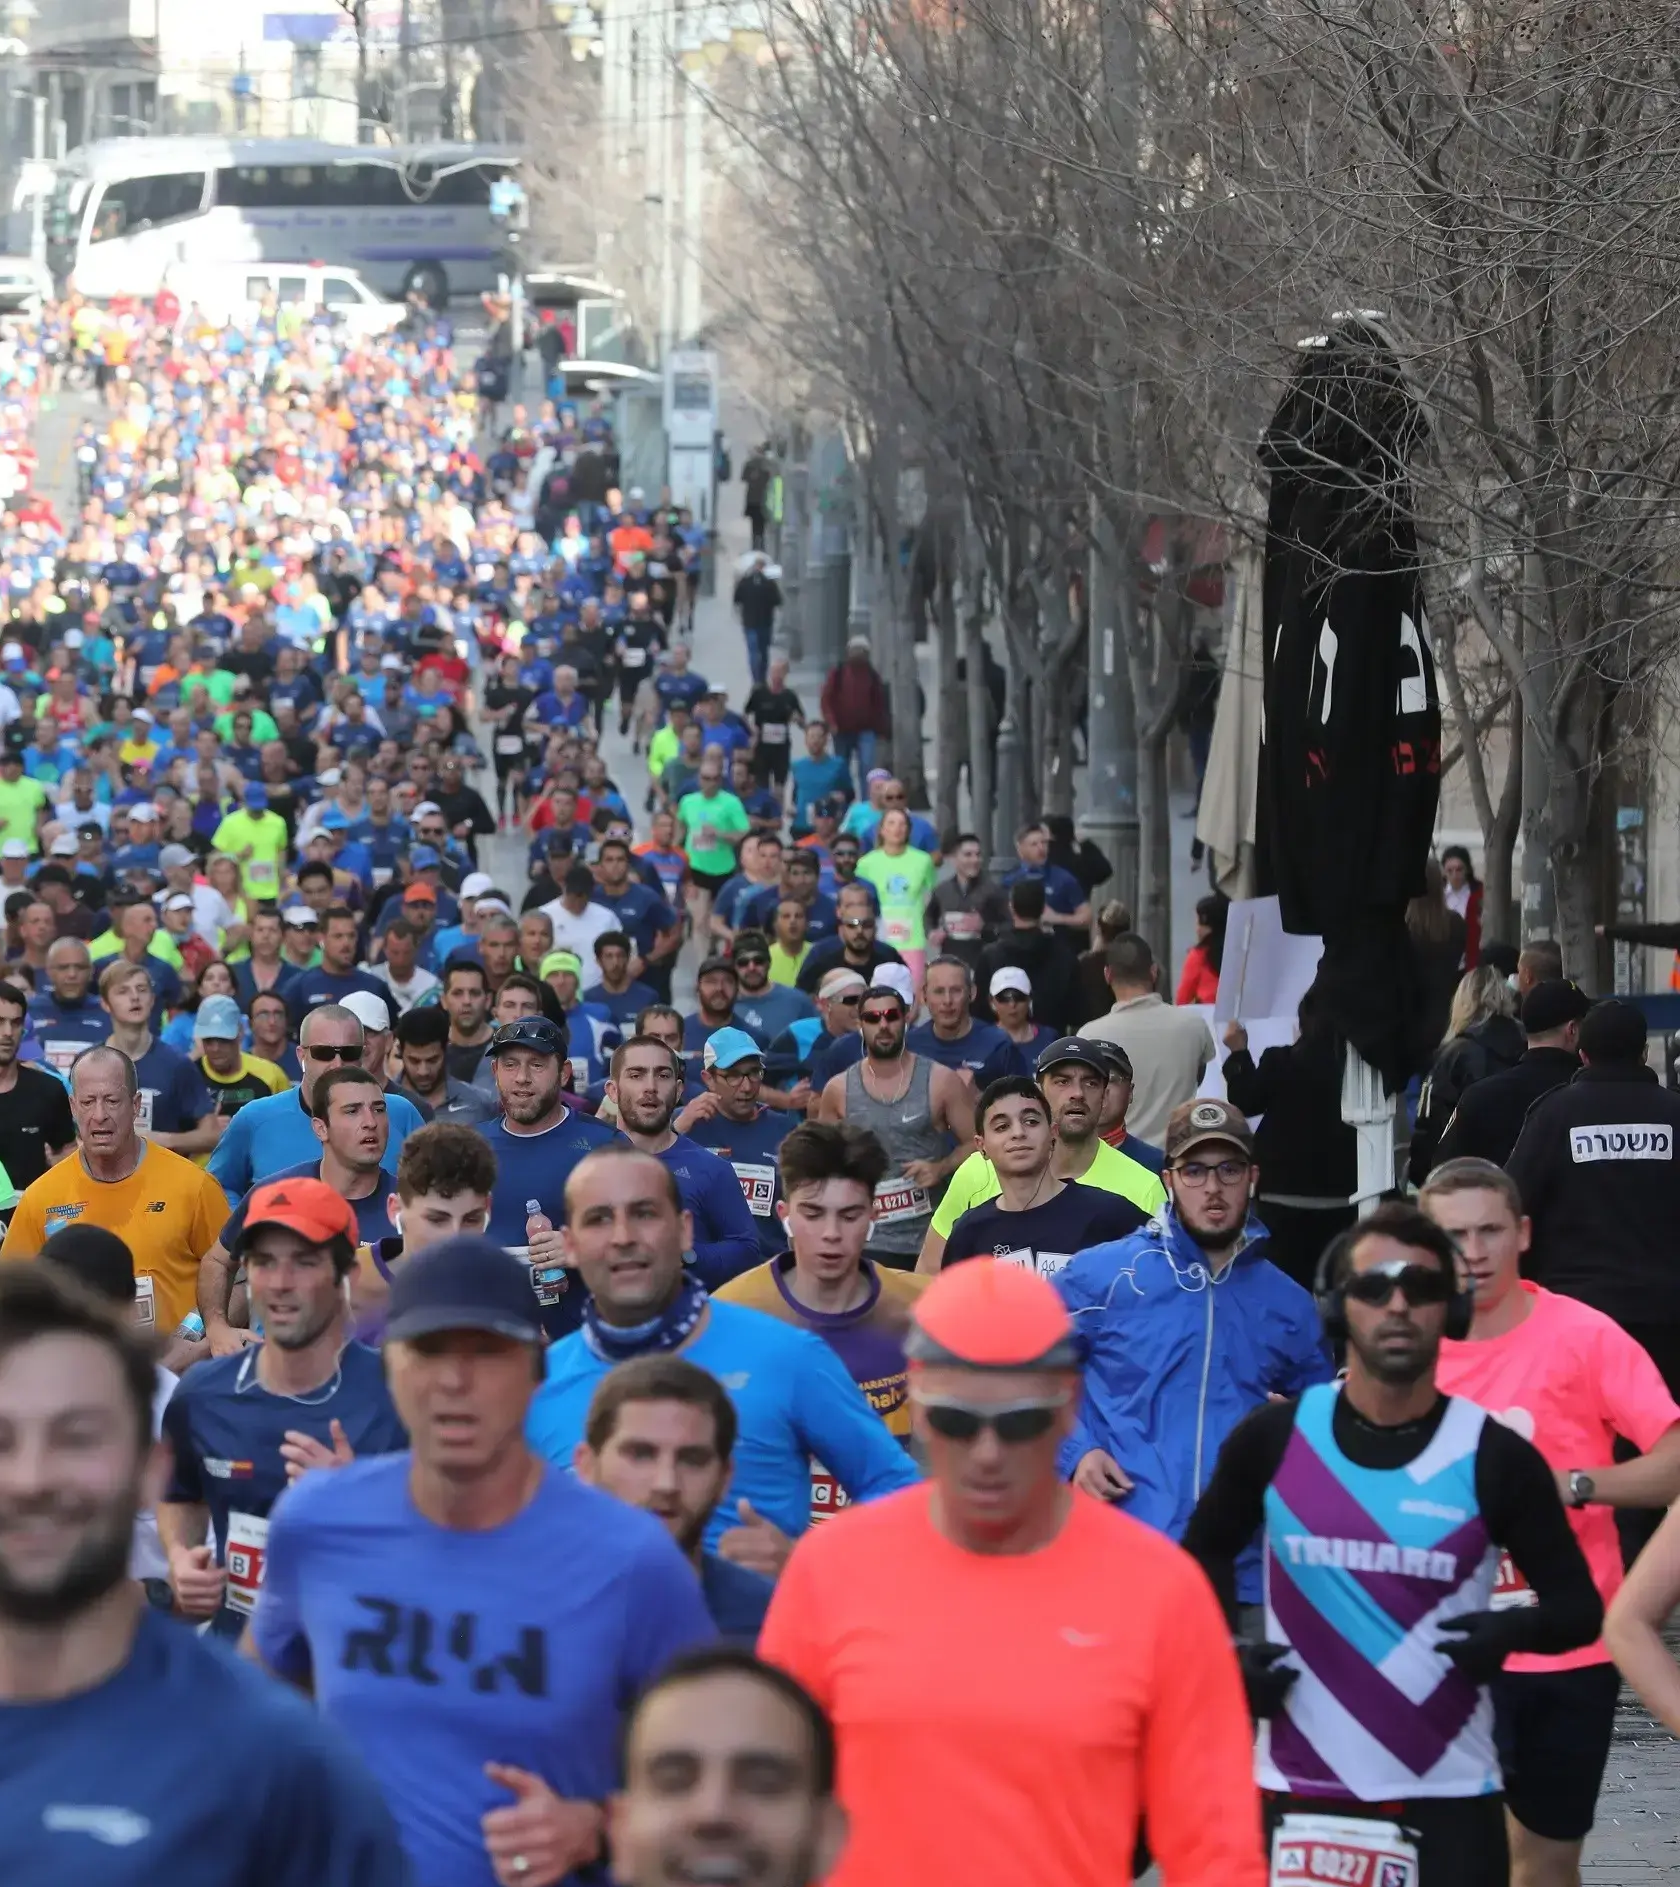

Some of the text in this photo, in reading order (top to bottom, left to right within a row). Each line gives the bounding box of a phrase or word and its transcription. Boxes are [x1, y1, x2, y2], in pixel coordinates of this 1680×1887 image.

[1575, 1133, 1669, 1154] משטרה
[815, 1486, 827, 1501] C
[232, 1555, 245, 1574] B
